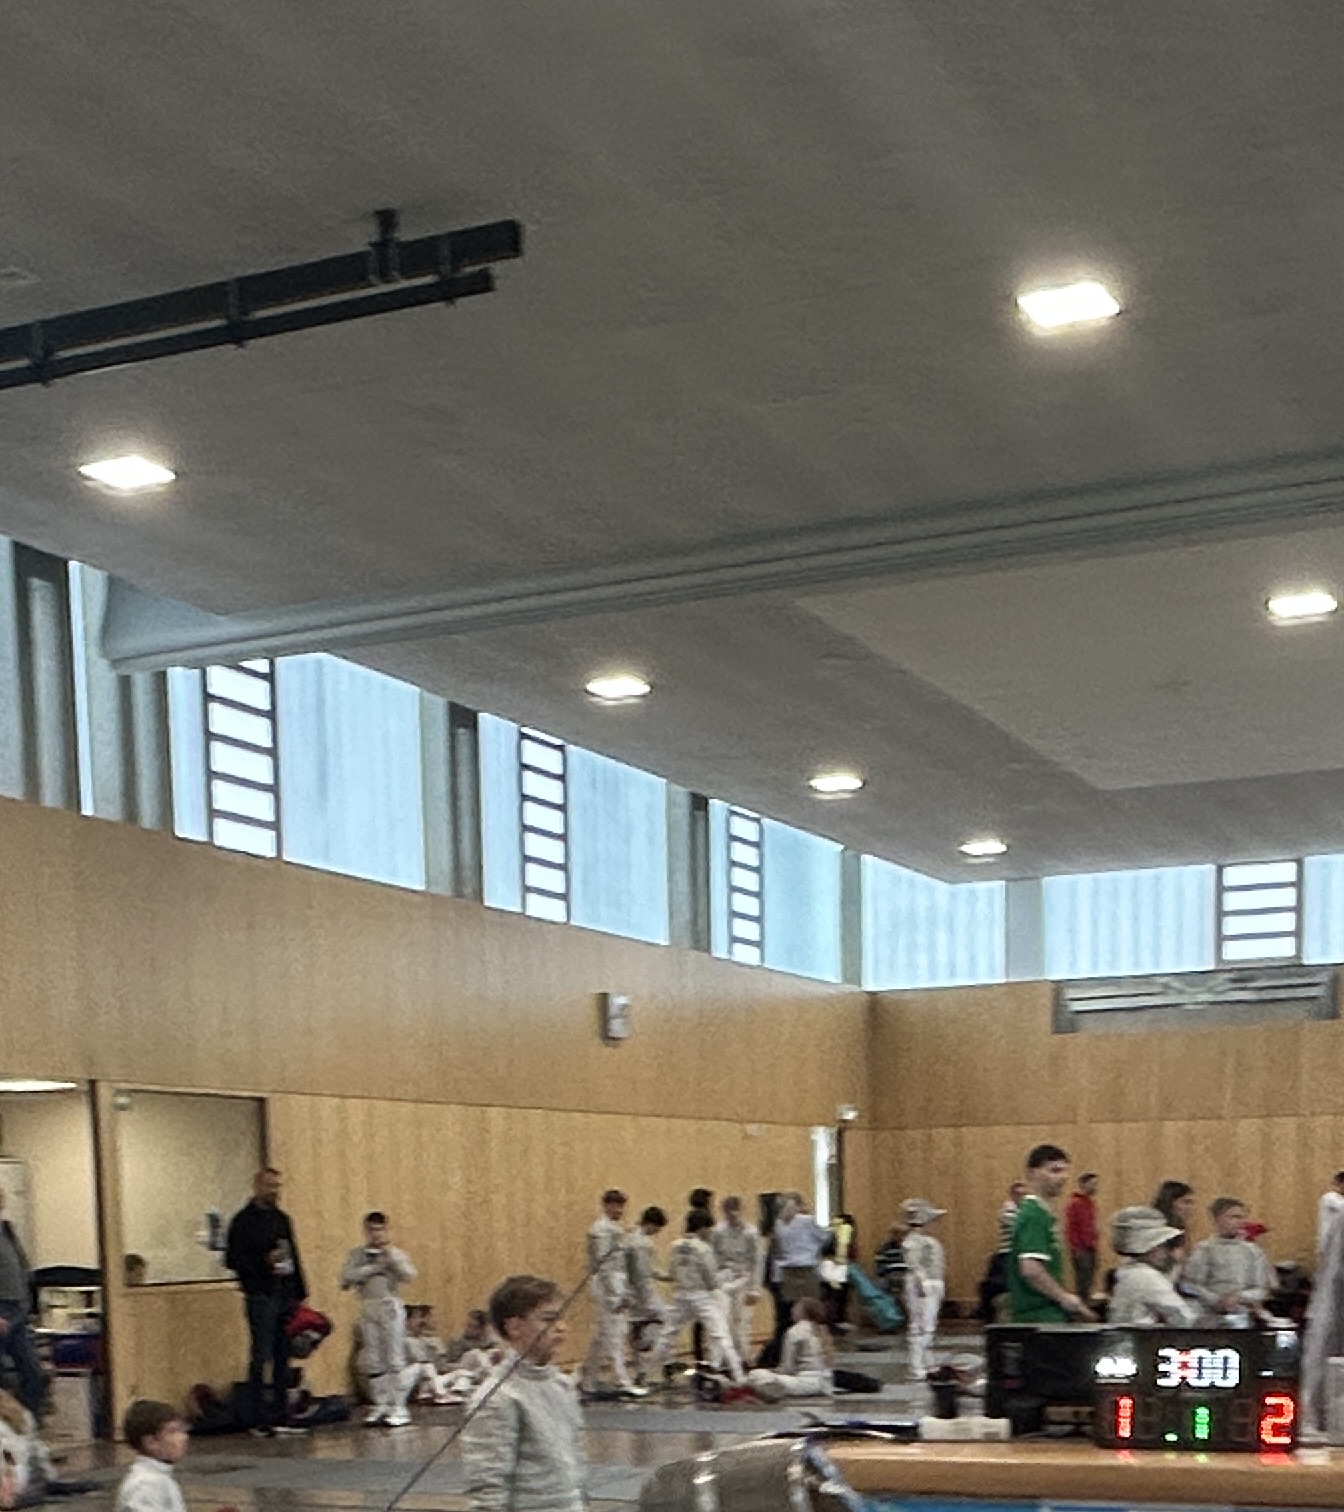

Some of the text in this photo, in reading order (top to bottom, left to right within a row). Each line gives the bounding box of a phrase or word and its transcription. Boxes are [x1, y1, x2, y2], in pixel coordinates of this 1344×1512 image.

[1156, 1348, 1240, 1388] 3:00
[1116, 1396, 1134, 1438] 1
[1259, 1395, 1295, 1444] 2
